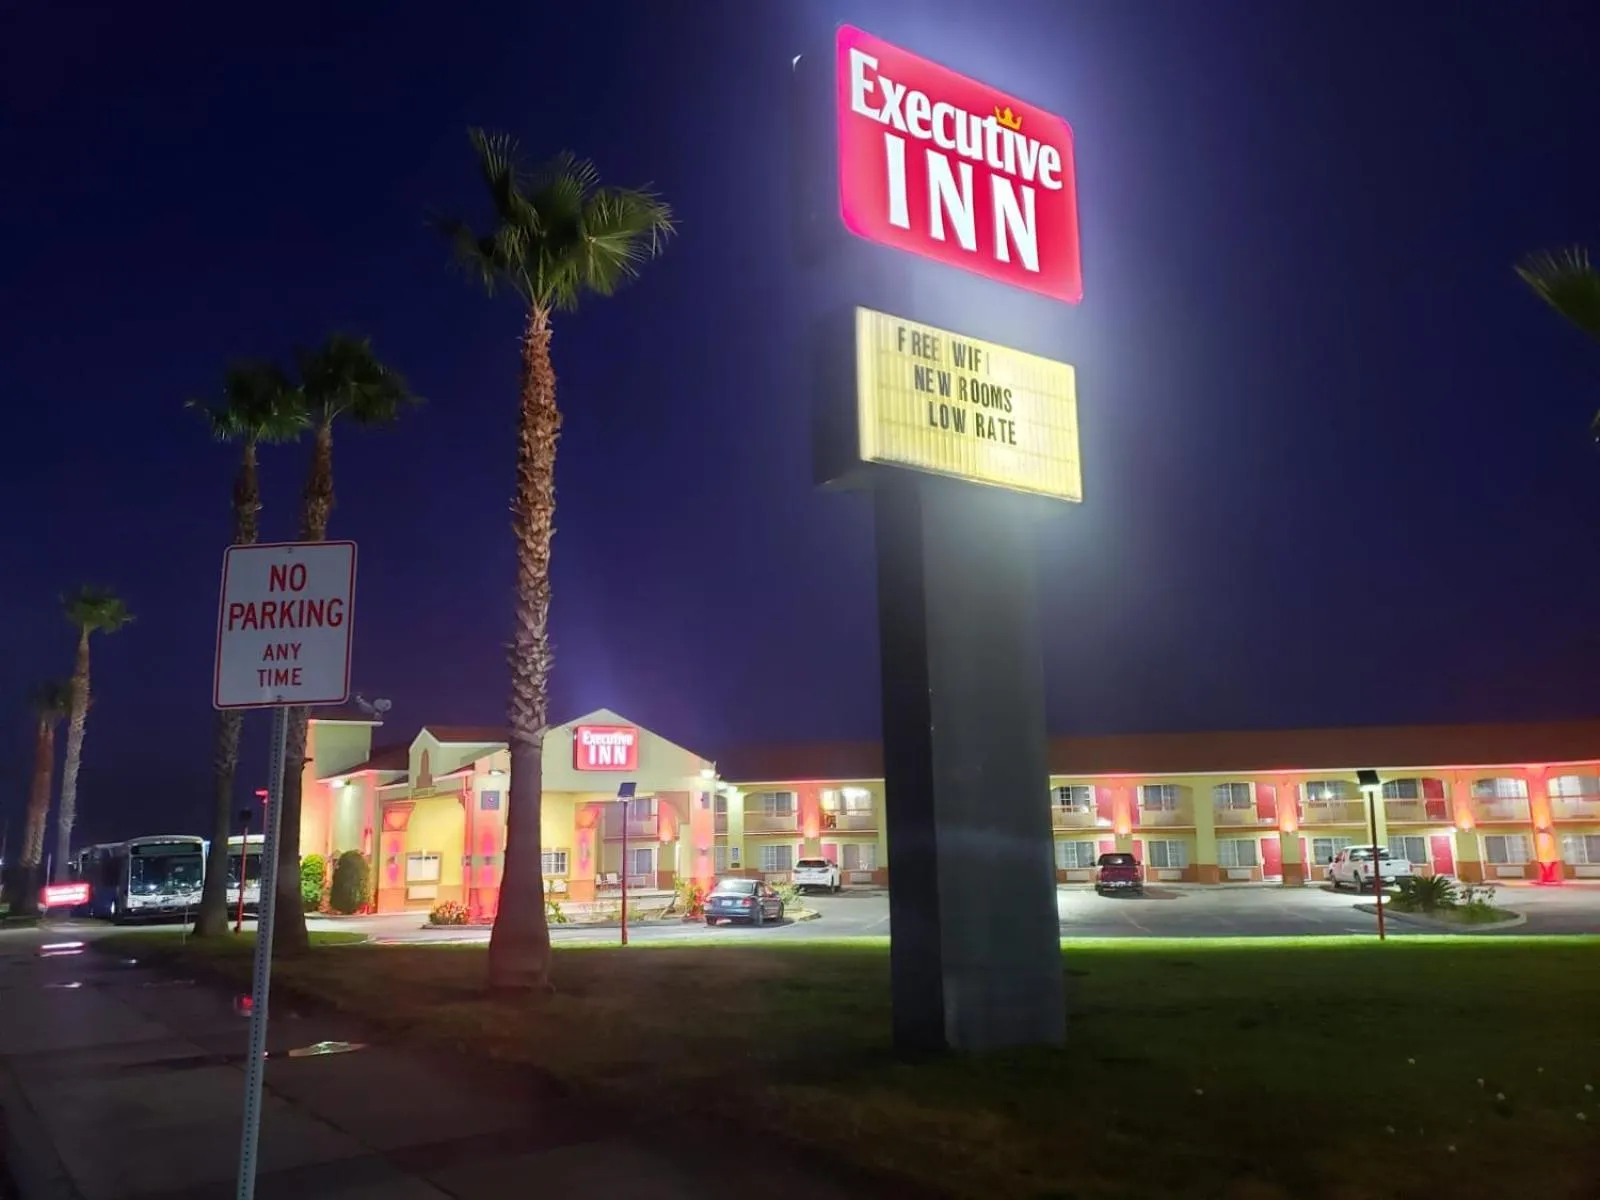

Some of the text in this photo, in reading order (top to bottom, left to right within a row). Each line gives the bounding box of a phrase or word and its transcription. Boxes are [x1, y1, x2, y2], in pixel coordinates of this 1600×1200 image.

[850, 47, 1062, 190] Executive
[884, 131, 1040, 273] INN
[897, 326, 939, 362] FREE
[914, 363, 1013, 413] NEW ROOMS
[928, 401, 1017, 446] LOW RATE
[269, 563, 308, 593] NO
[228, 598, 344, 632] PARKING
[262, 643, 302, 662] ANY
[257, 667, 303, 688] TIME
[588, 744, 627, 765] INN
